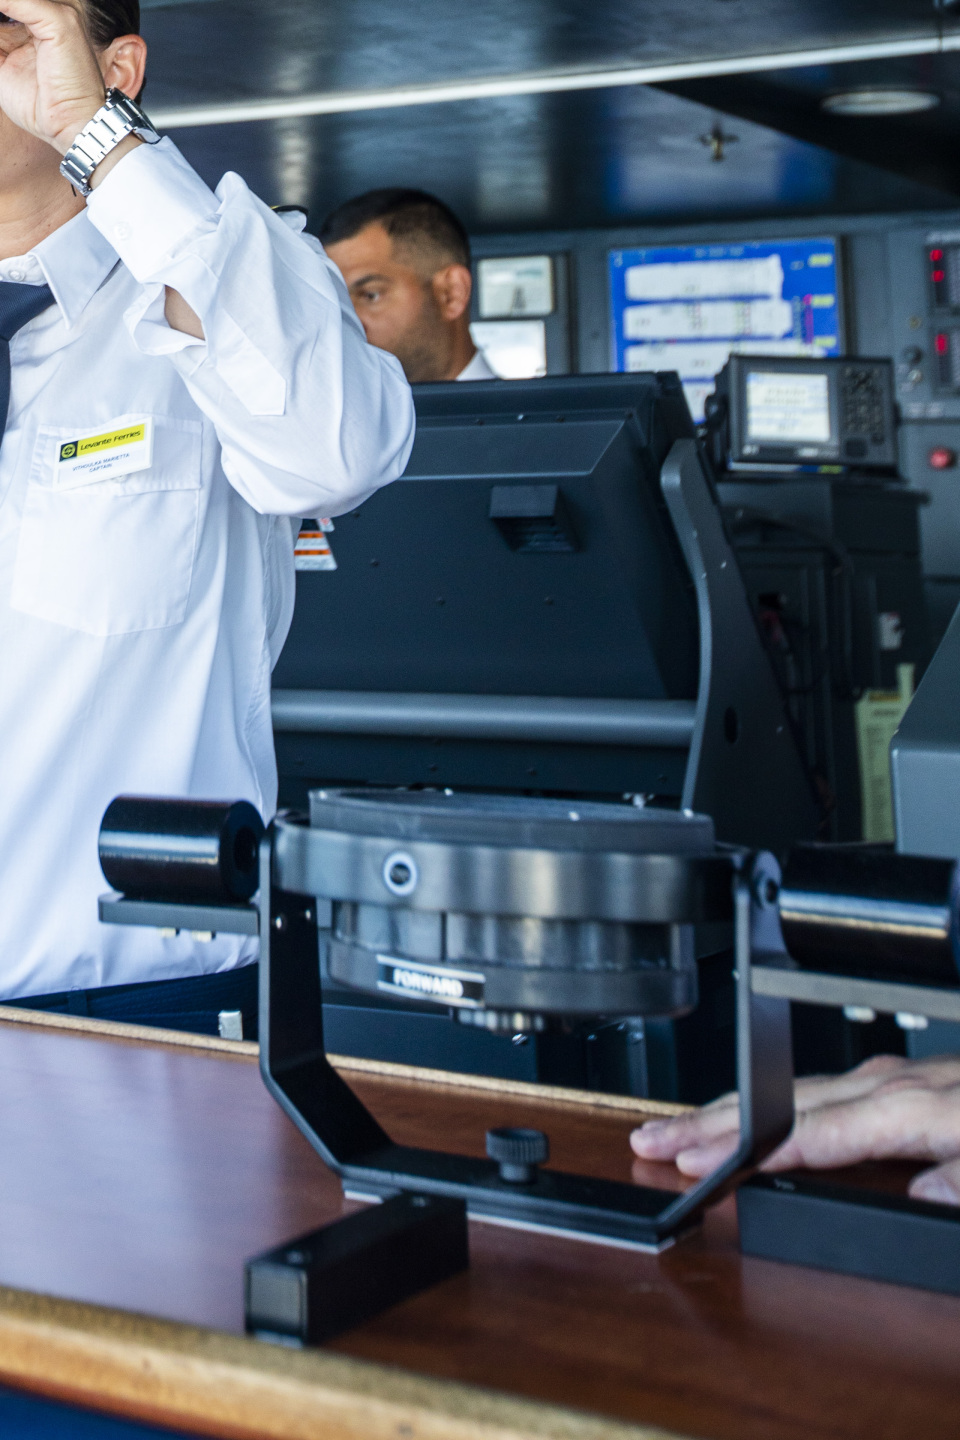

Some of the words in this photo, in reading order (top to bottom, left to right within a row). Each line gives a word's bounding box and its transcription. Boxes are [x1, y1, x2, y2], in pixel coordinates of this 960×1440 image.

[80, 438, 112, 451] Levante
[113, 430, 141, 442] Ferries
[89, 463, 113, 472] CAPTAIN
[392, 967, 464, 998] FORWARD
